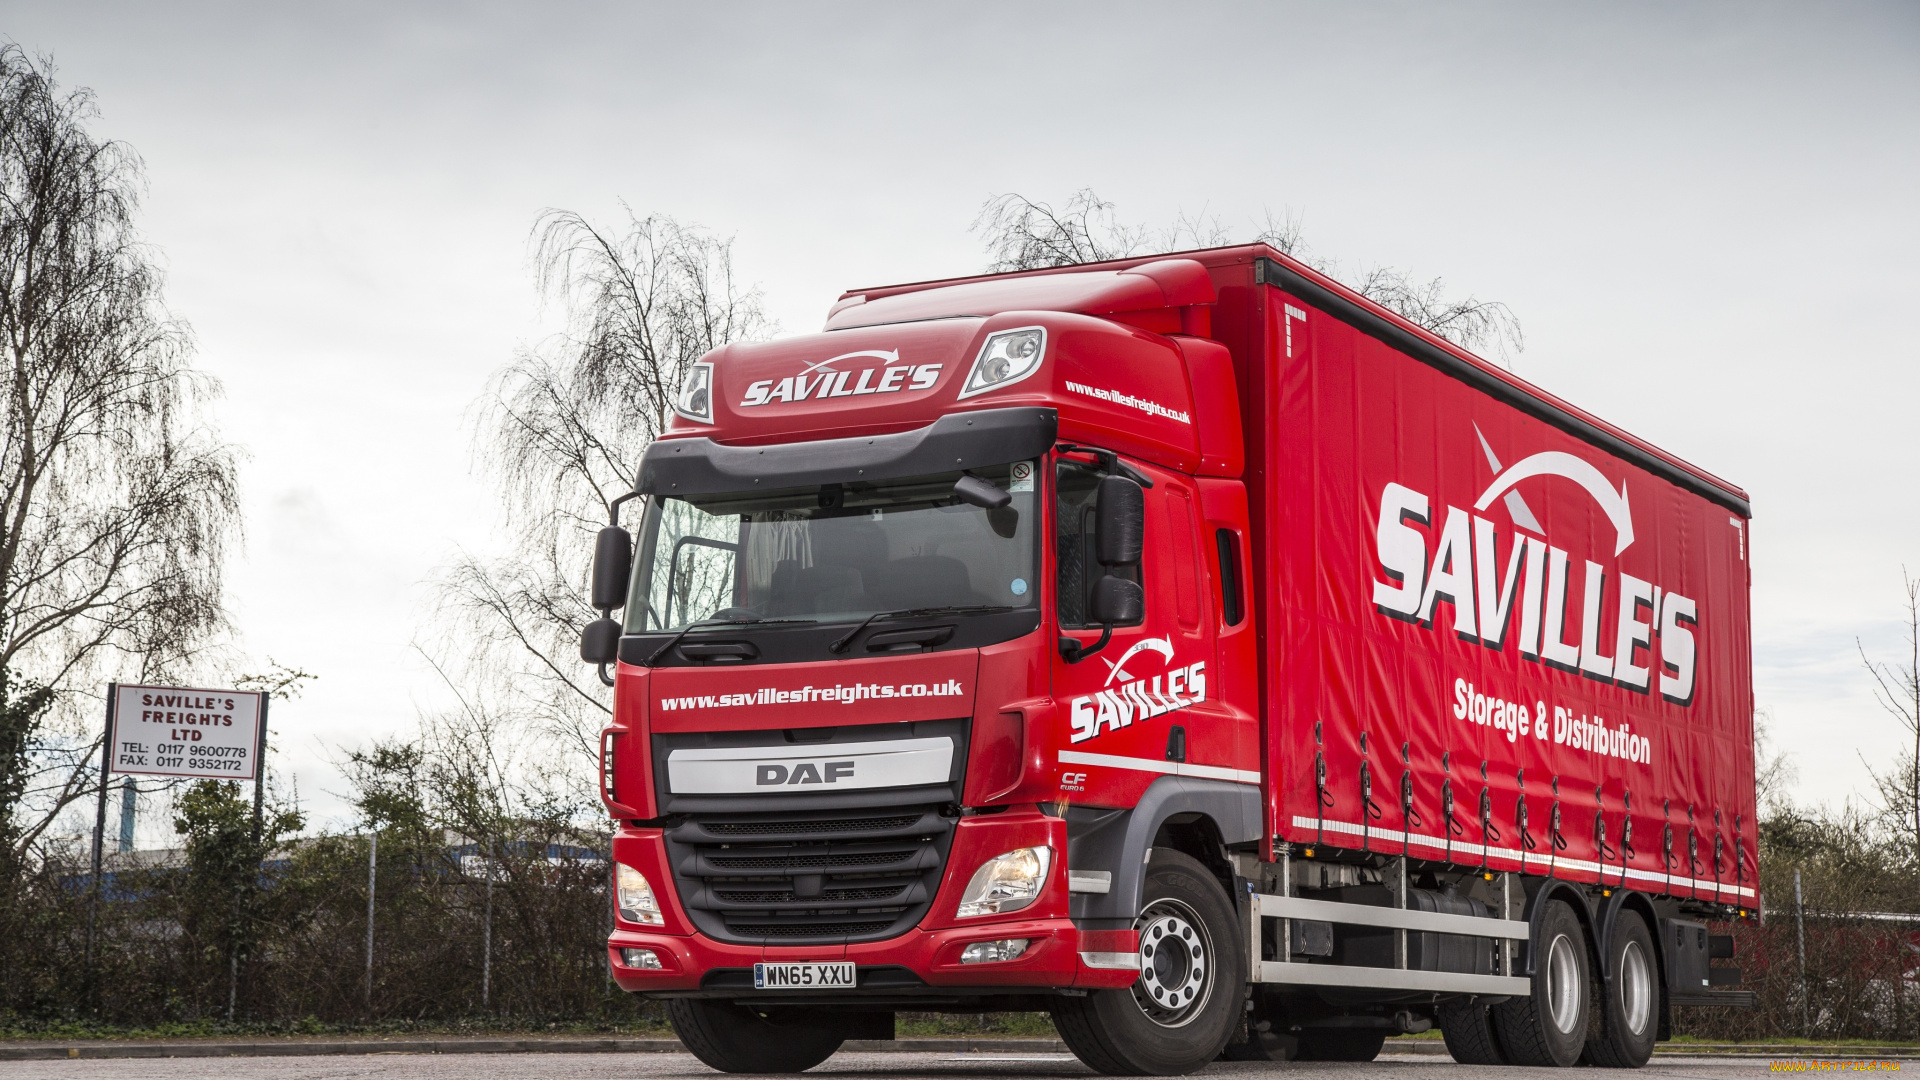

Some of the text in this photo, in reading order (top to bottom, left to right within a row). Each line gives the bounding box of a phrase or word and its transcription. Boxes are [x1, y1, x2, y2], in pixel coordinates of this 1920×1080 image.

[739, 363, 943, 407] SAVILLE'S
[1065, 380, 1191, 425] www.savillesfreights.co.uk
[1372, 482, 1699, 707] SAVILLE'S
[142, 694, 235, 711] SAVILLE'S
[661, 679, 964, 711] www.savillesfreights.co.uk
[1070, 661, 1206, 745] SAVILLE'S
[142, 711, 233, 727] FREIGHTS
[1453, 677, 1651, 765] Storage & Distribution
[171, 729, 203, 742] LTD
[121, 742, 247, 758] TEL: 0117 9600778
[119, 755, 242, 771] FAX: 0117 9352172
[756, 761, 855, 786] DAF
[1061, 772, 1087, 785] CF
[1060, 784, 1079, 792] EURO
[766, 965, 853, 985] WN65 XXU
